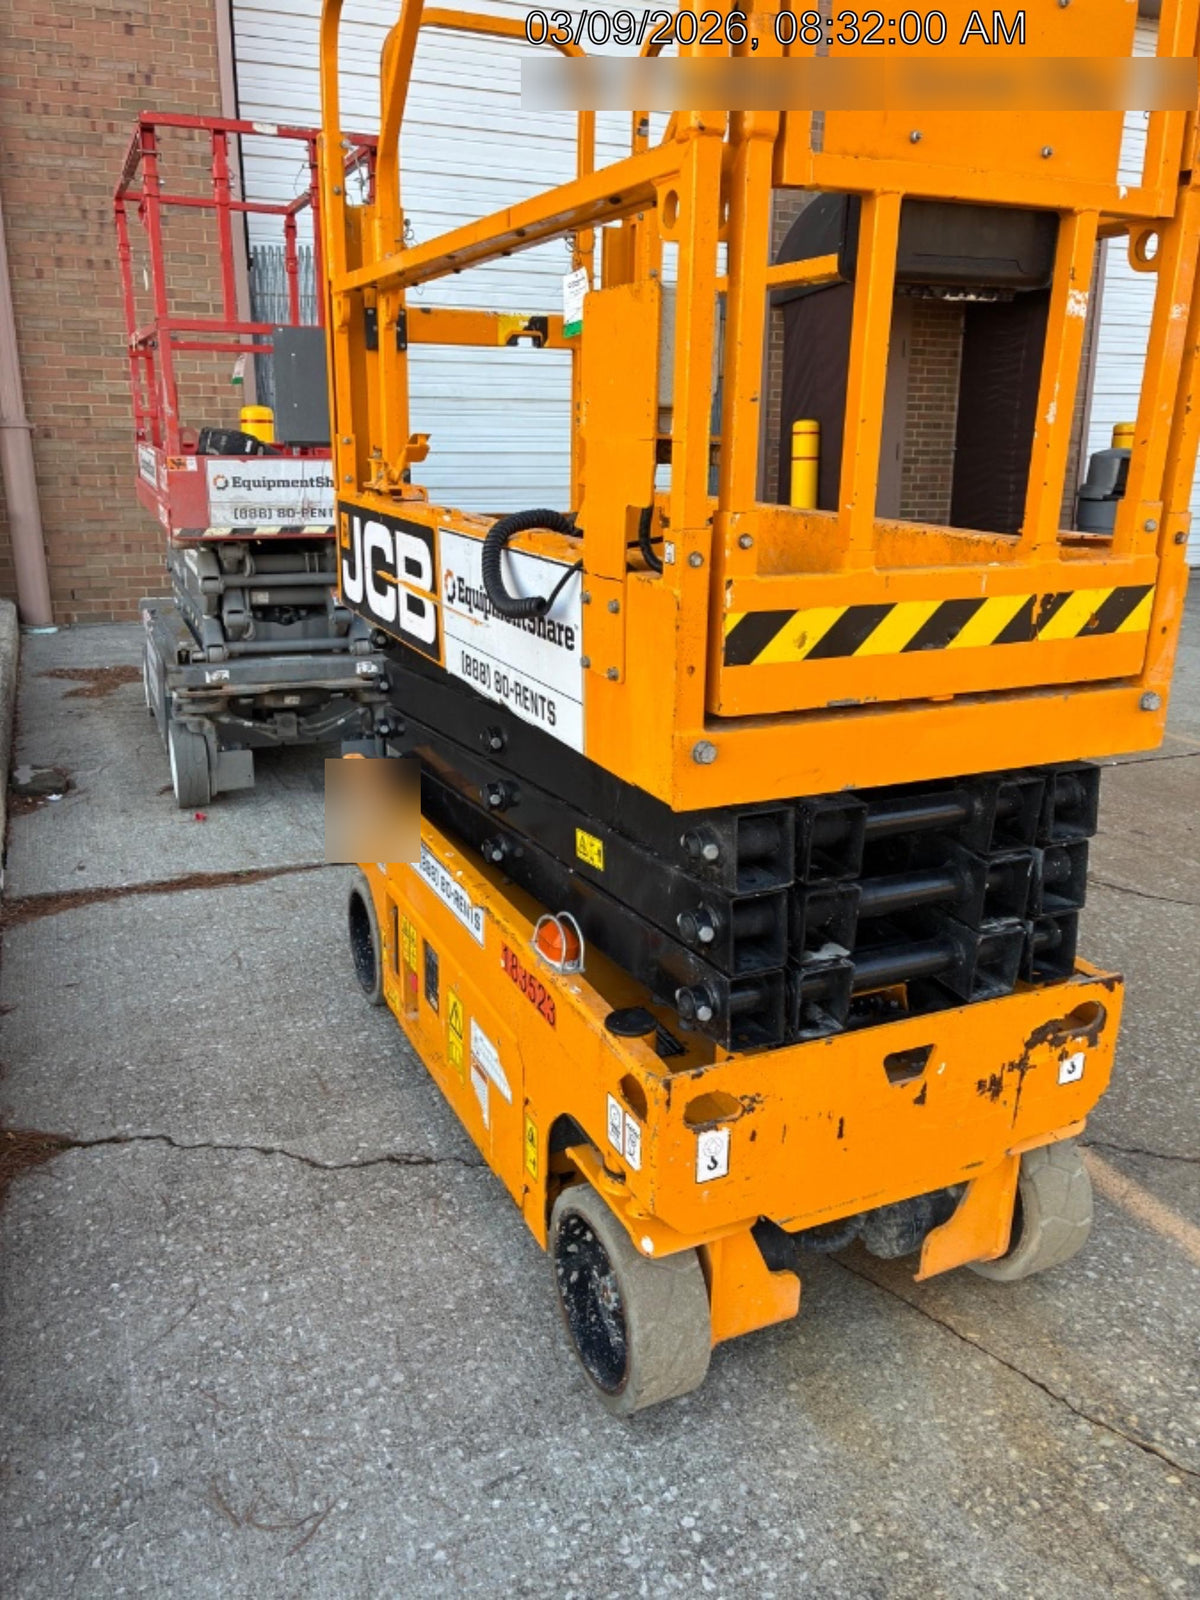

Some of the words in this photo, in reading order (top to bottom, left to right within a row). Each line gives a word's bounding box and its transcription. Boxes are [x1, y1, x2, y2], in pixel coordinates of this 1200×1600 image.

[342, 515, 436, 645] JCB
[456, 576, 575, 651] EquiptShare
[461, 650, 491, 690] (888)
[493, 671, 557, 727] 80-RENTS
[503, 945, 556, 1027] 183523
